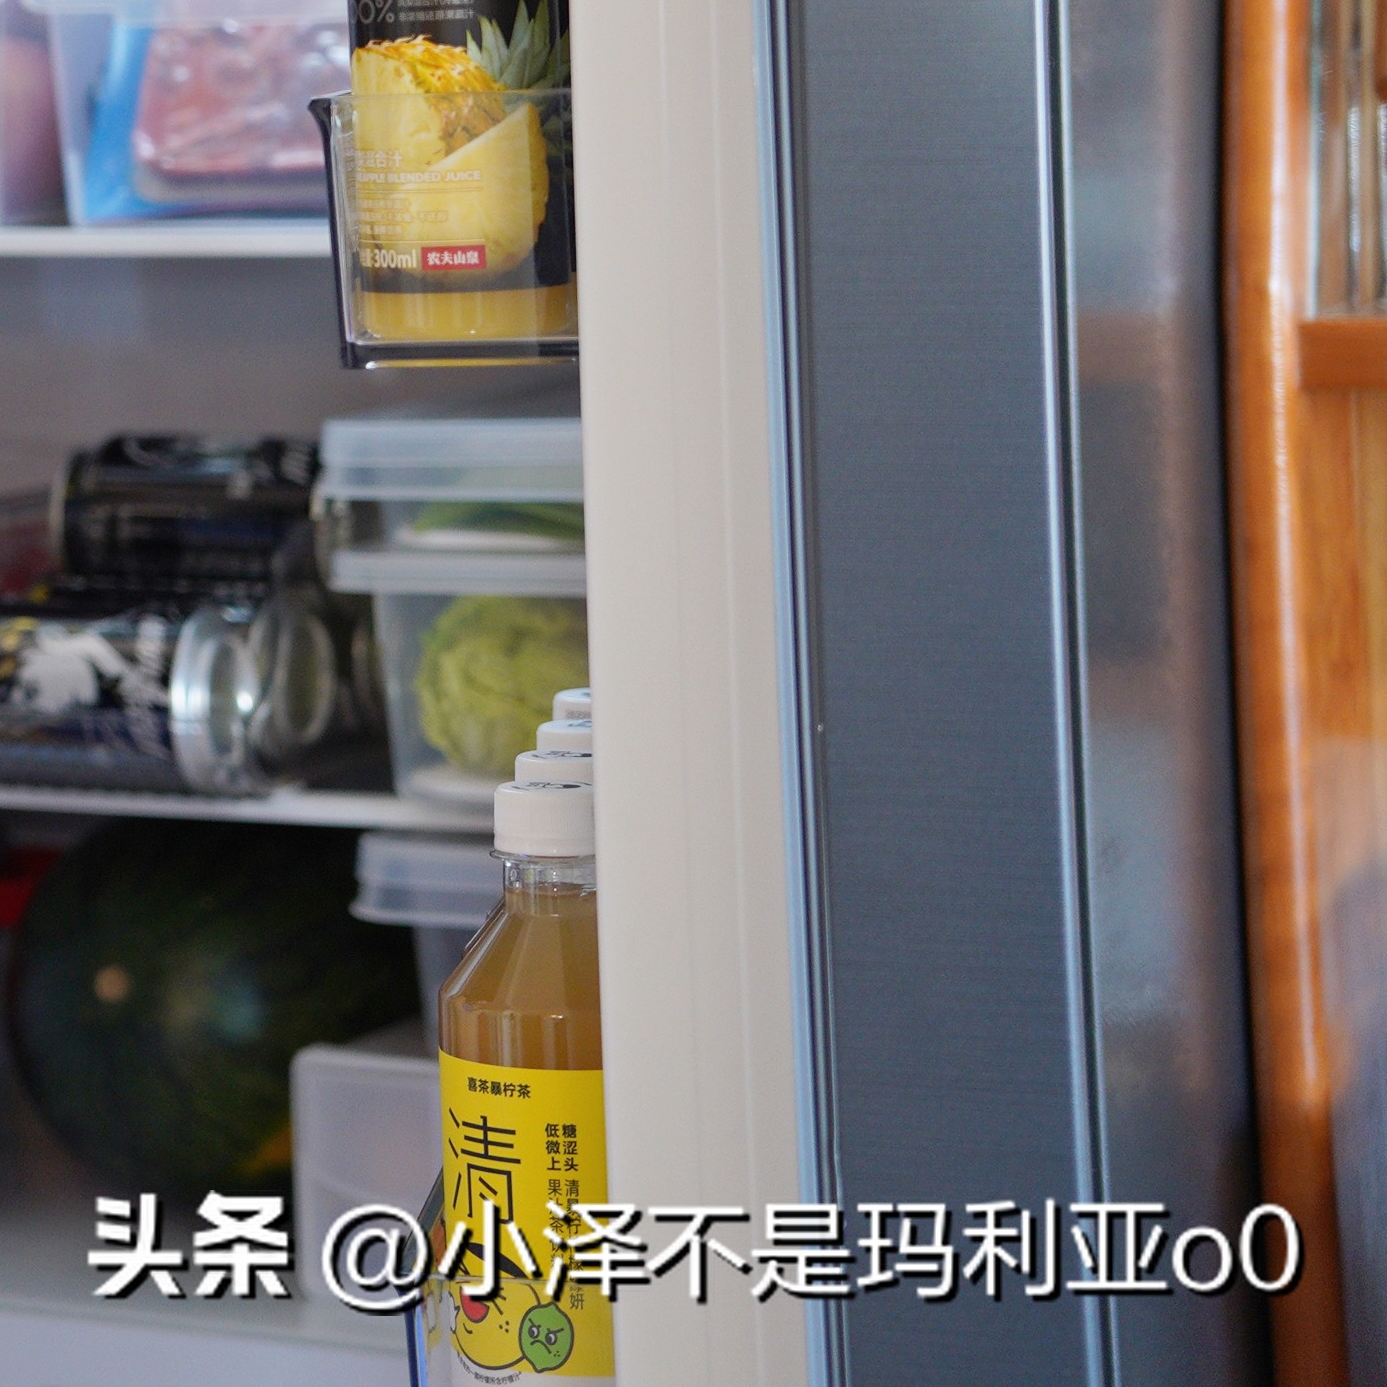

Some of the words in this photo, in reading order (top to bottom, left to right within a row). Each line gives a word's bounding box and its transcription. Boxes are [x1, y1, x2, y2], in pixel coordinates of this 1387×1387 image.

[387, 171, 441, 183] BLENDED
[444, 170, 482, 182] JUICE
[427, 250, 480, 265] 农夫山泉
[467, 1076, 531, 1100] 喜茶暴柠茶
